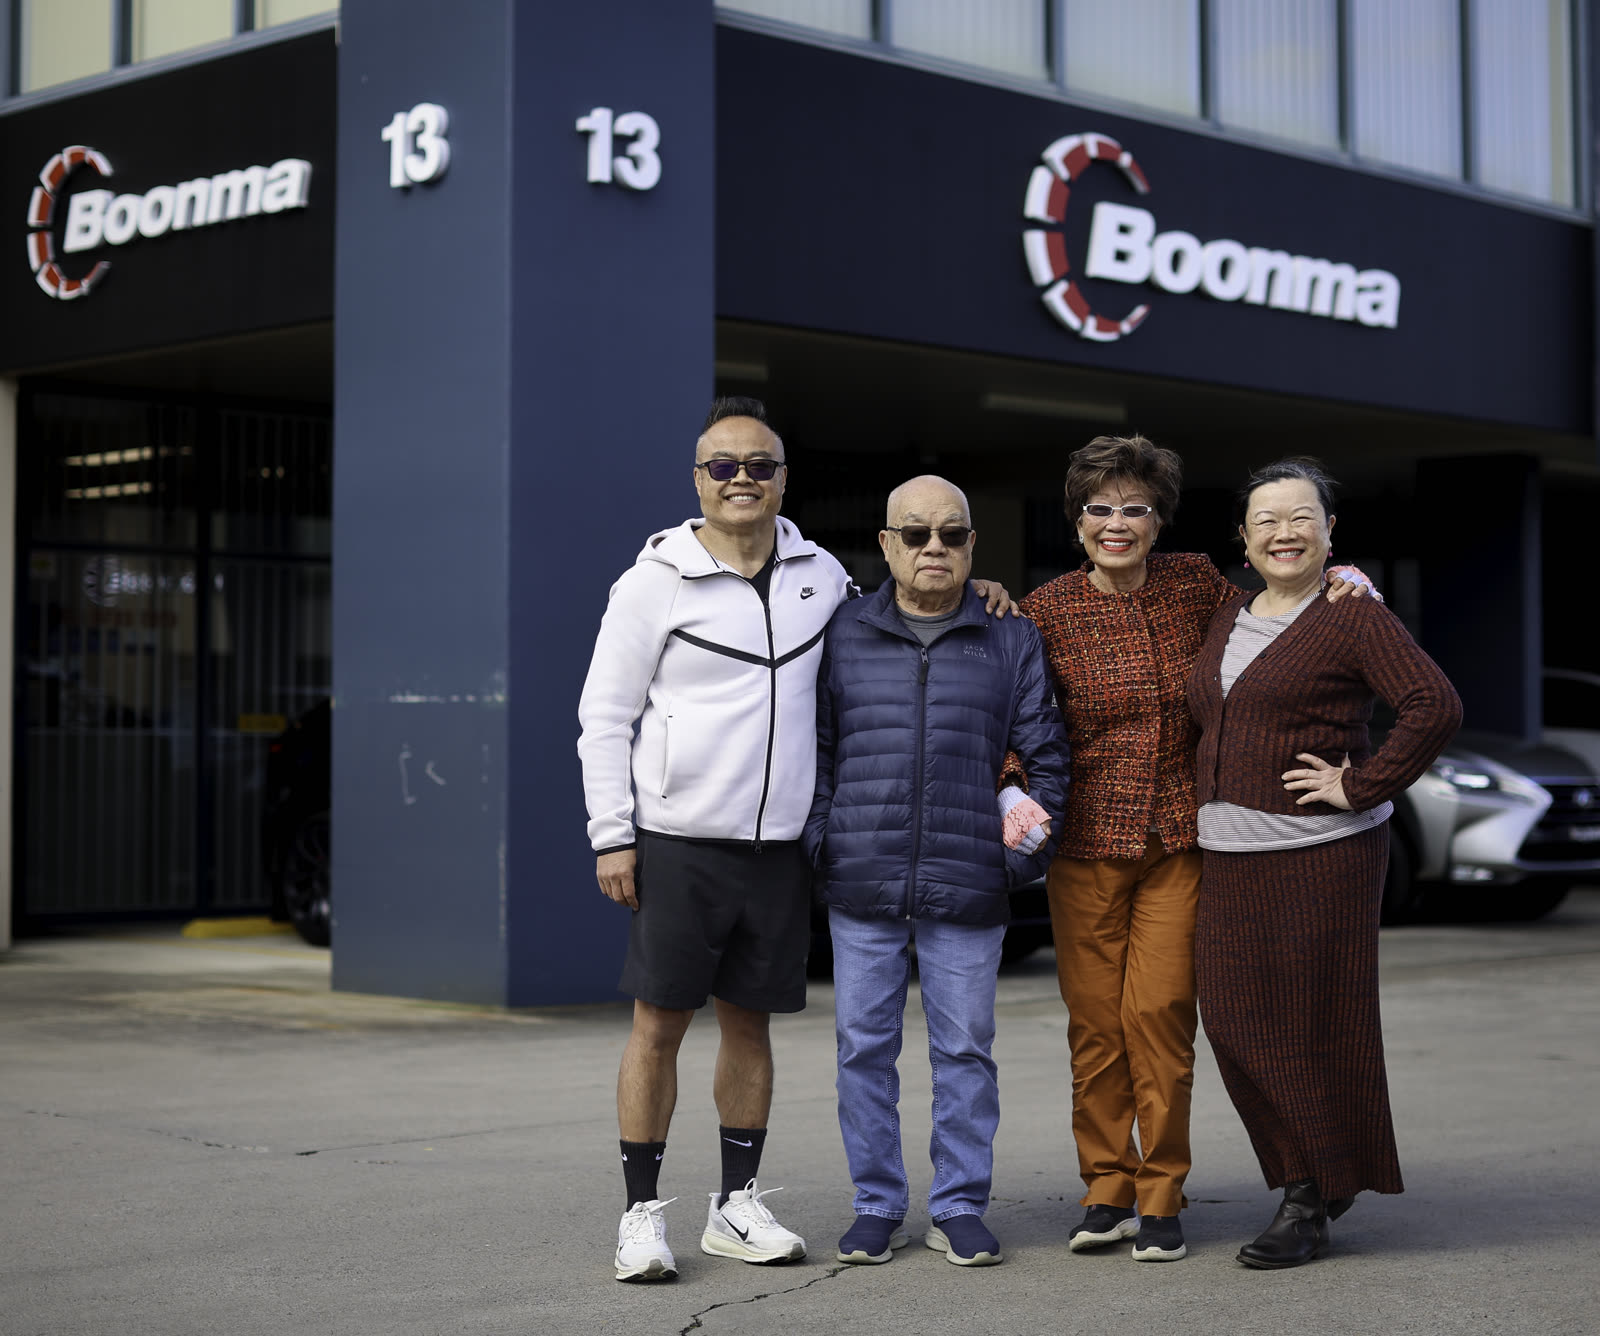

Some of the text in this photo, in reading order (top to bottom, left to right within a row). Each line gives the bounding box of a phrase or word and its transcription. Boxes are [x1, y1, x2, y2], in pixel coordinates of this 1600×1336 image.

[381, 102, 450, 188] 13
[575, 106, 662, 190] 13
[63, 158, 312, 254] Boonma
[1084, 200, 1401, 329] Boonma
[801, 586, 814, 594] NIKE
[965, 644, 984, 652] JACK
